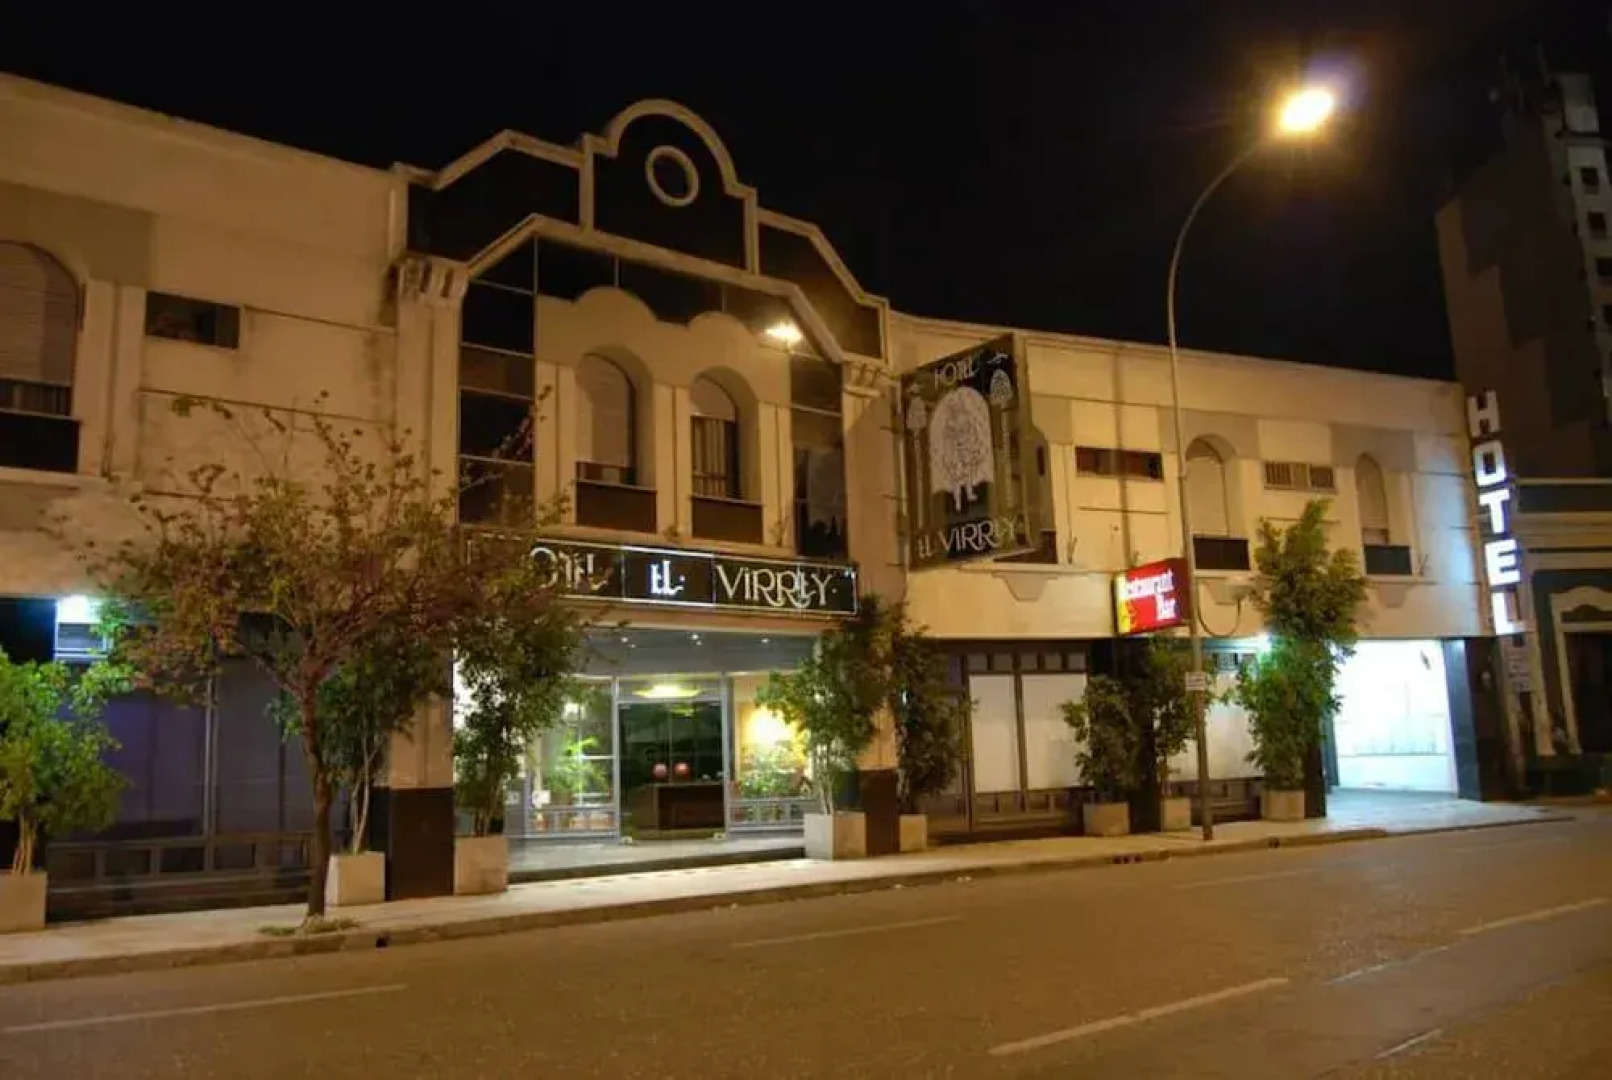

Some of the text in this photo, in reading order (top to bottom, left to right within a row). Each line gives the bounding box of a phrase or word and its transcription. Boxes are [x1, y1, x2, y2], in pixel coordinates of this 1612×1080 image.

[530, 547, 615, 591] OTEL
[716, 561, 833, 607] VIRREY
[1467, 390, 1527, 636] HOTEL
